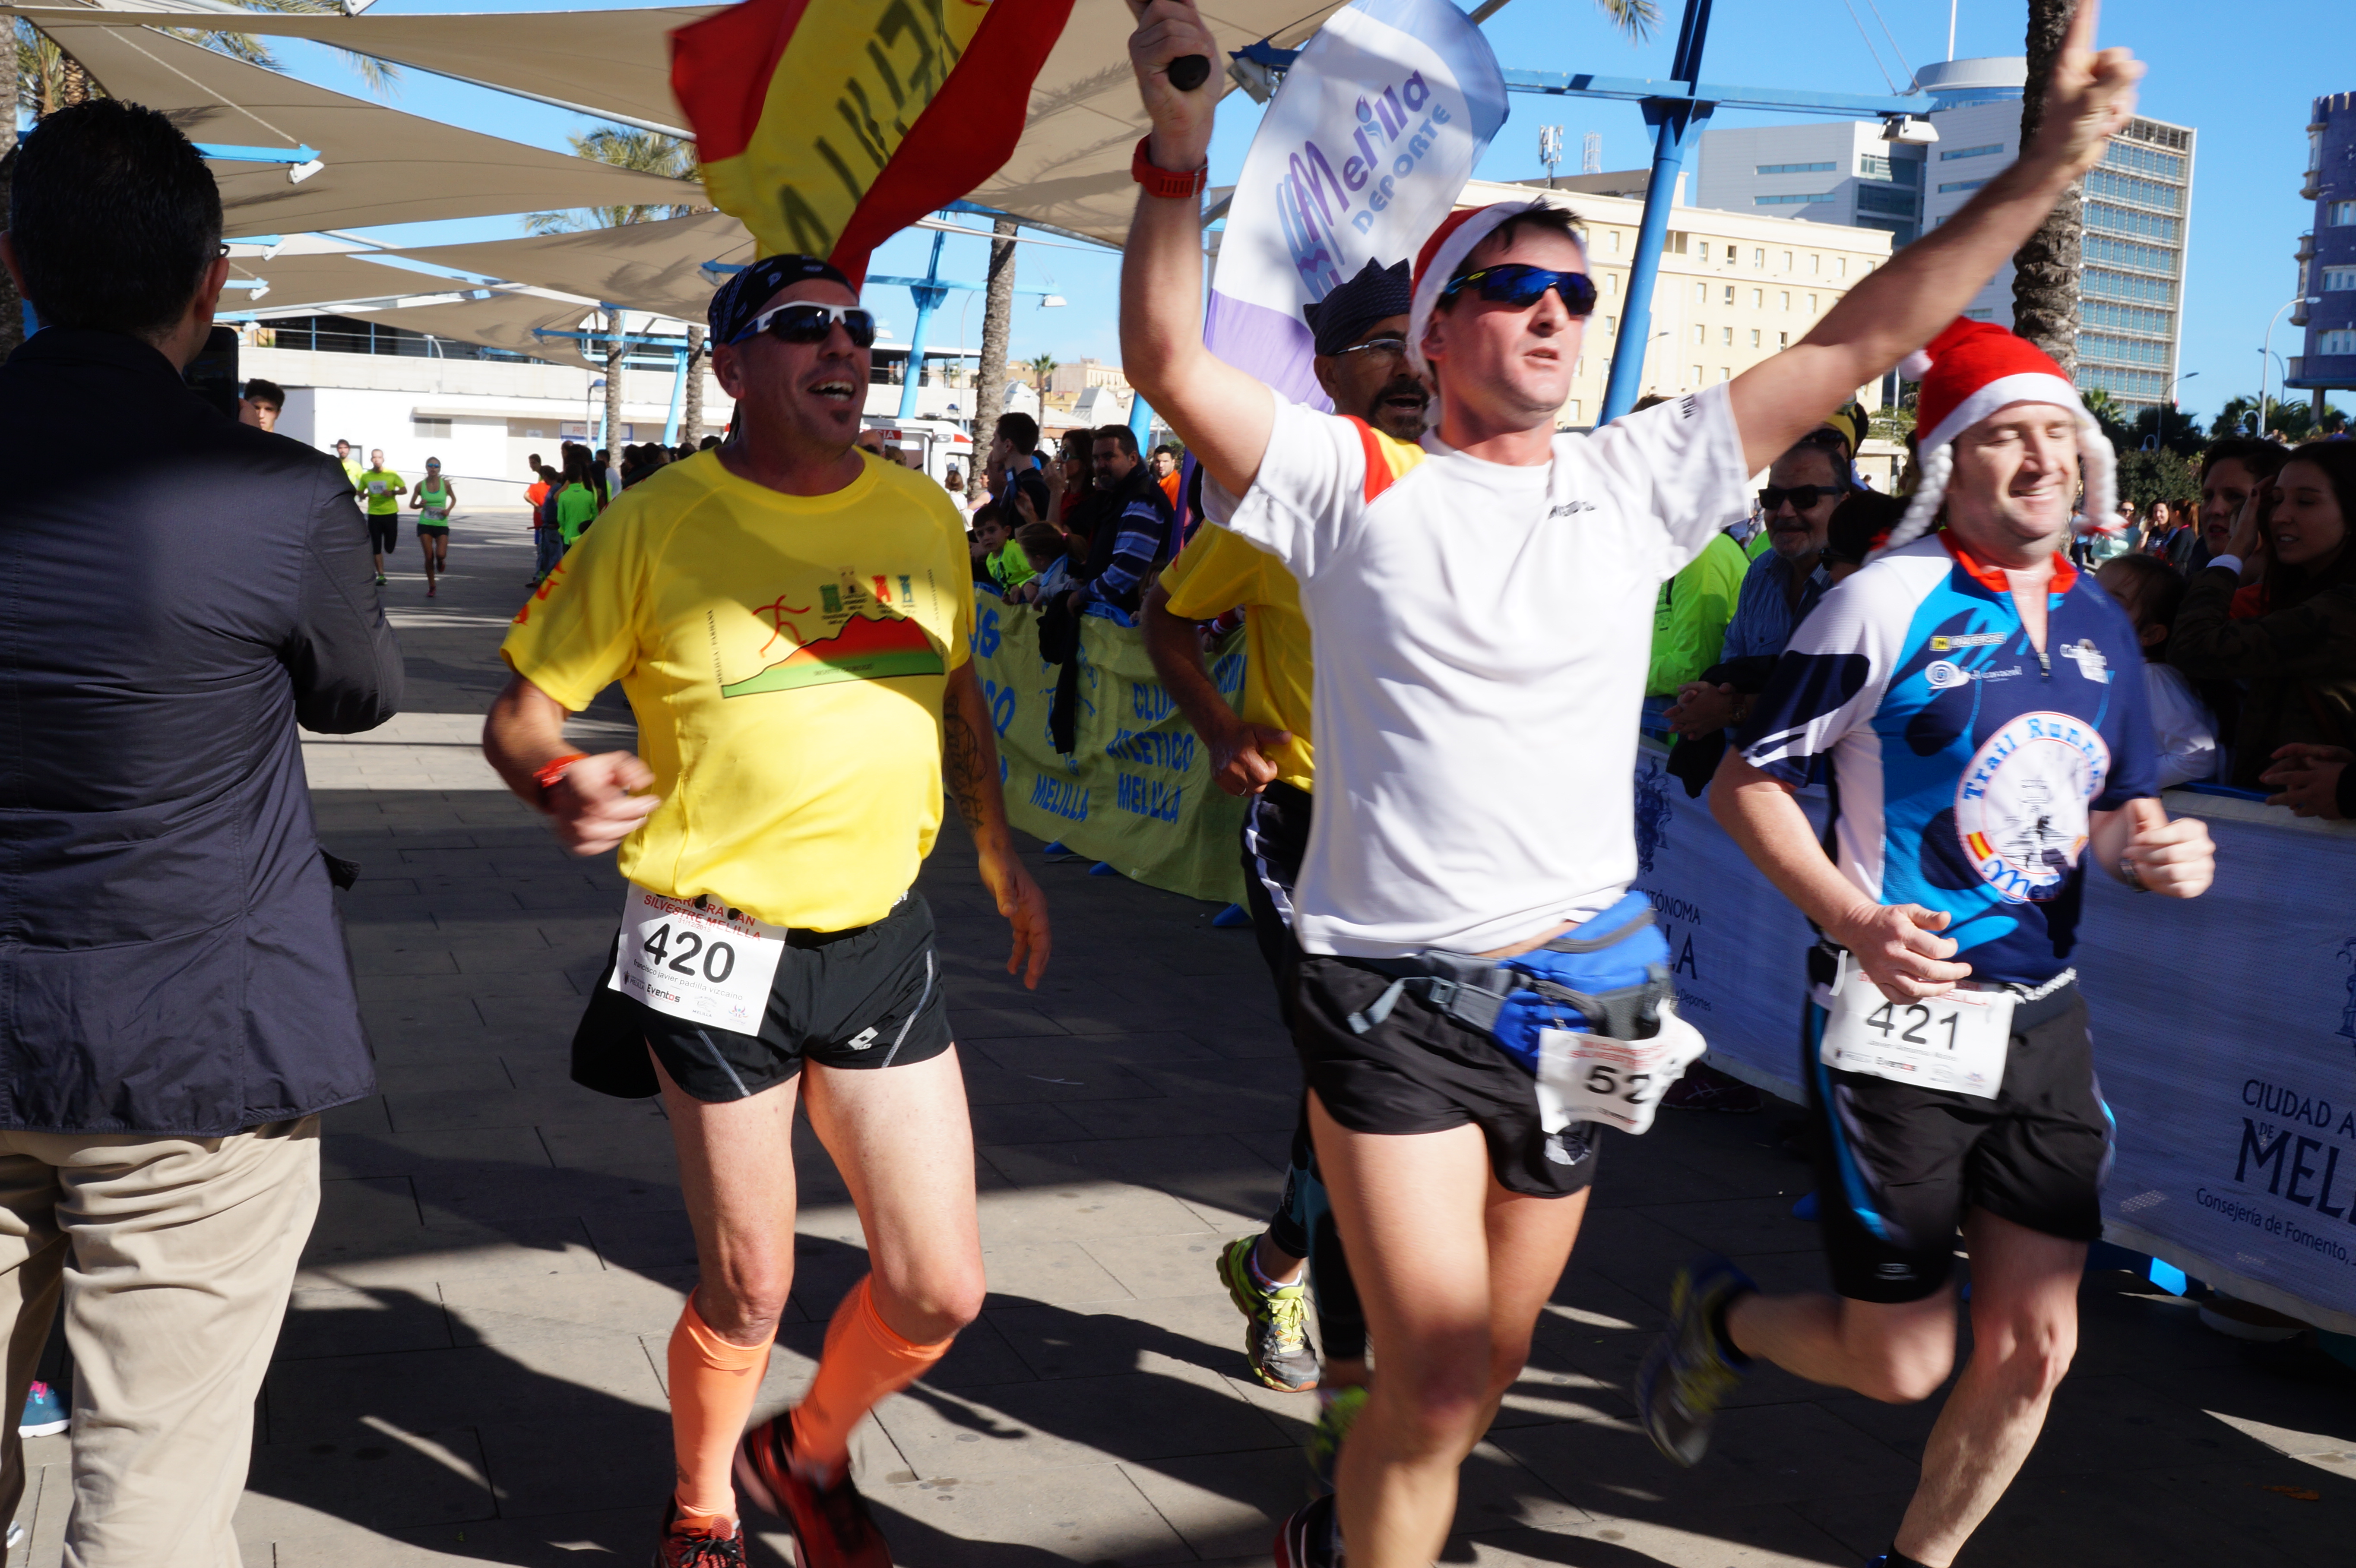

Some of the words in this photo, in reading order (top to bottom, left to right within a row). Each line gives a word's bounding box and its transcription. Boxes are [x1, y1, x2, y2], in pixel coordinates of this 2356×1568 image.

[1289, 69, 1431, 242] Melilla
[1352, 104, 1451, 235] DEPORTE
[1963, 733, 2018, 800] Trail
[1029, 773, 1090, 823] MELILLA
[1118, 773, 1182, 825] MELILLA
[643, 895, 703, 924] SILVESTRE
[707, 917, 761, 941] MELILLA
[678, 917, 711, 933] 31/12/2015
[643, 923, 735, 983] 420
[630, 978, 644, 991] MELILLA
[633, 959, 657, 976] francisco
[657, 970, 680, 983] javier
[679, 978, 707, 992] padilla
[709, 986, 743, 1001] vizcaino
[646, 983, 681, 1003] Eventos
[1679, 988, 1711, 1012] Deportes
[692, 1009, 712, 1018] MELILLA
[1866, 1002, 1959, 1050] 421
[2242, 1079, 2332, 1128] CIUDAD
[2259, 1122, 2275, 1139] DE
[2196, 1187, 2262, 1227] Consejería
[2264, 1214, 2283, 1235] de
[2284, 1221, 2350, 1265] Fomento,
